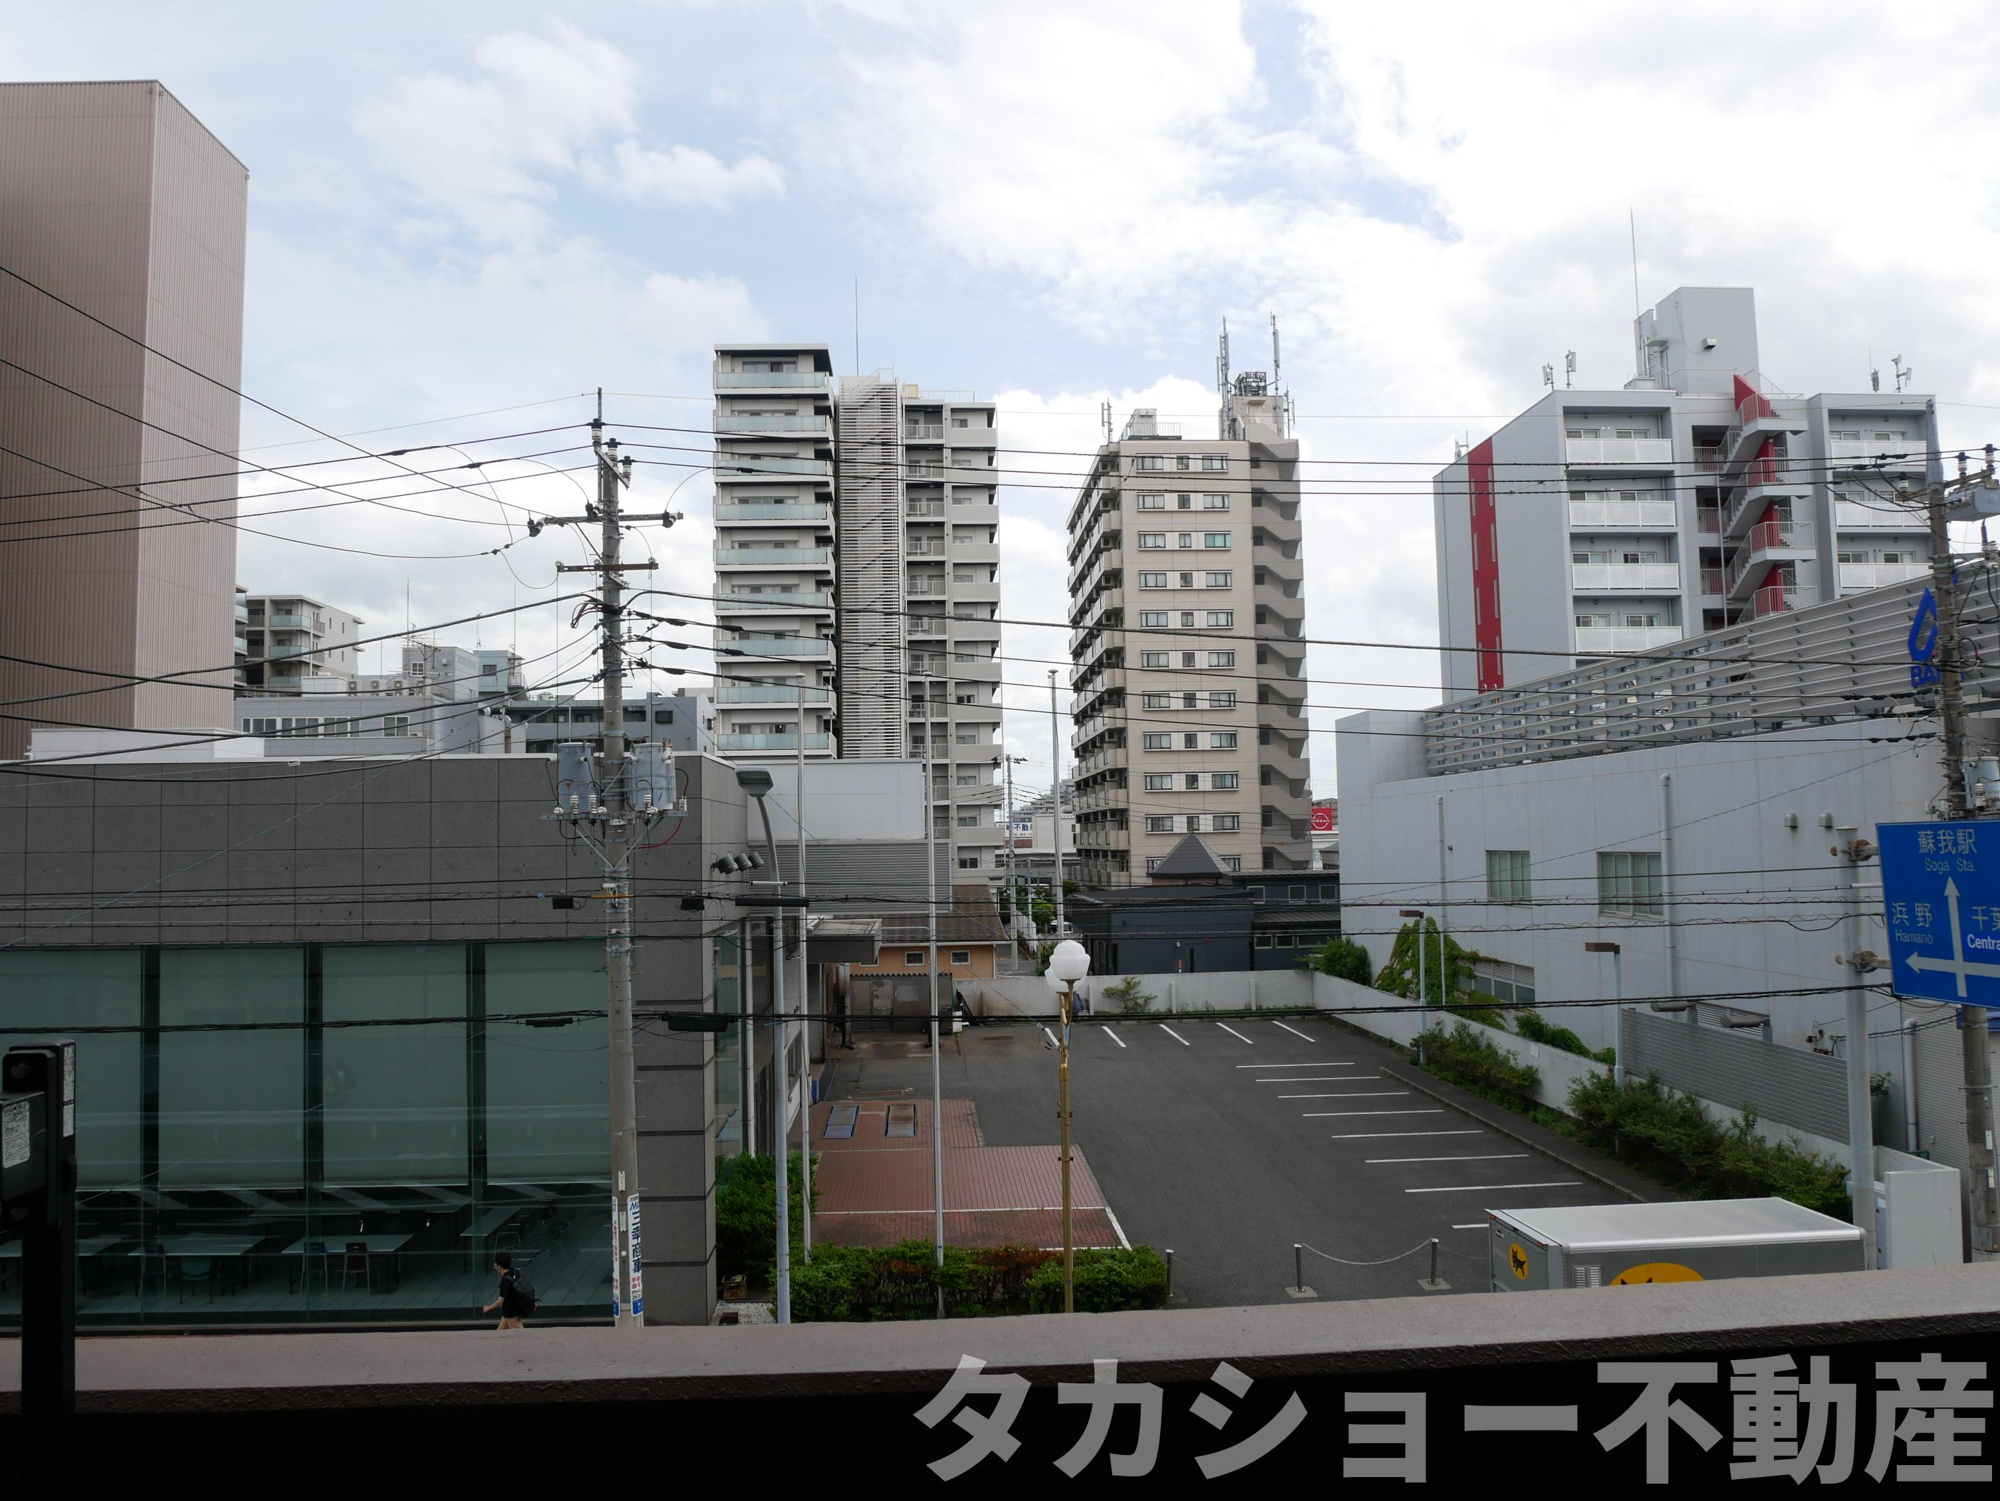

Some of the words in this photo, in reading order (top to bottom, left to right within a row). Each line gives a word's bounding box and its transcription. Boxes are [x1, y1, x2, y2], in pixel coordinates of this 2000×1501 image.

[1917, 829, 1978, 855] 蘇我駅
[1924, 858, 1950, 874] Soga
[1956, 858, 1977, 872] Sta.
[1891, 901, 1933, 927] 浜野
[1894, 928, 1934, 945] Hamano
